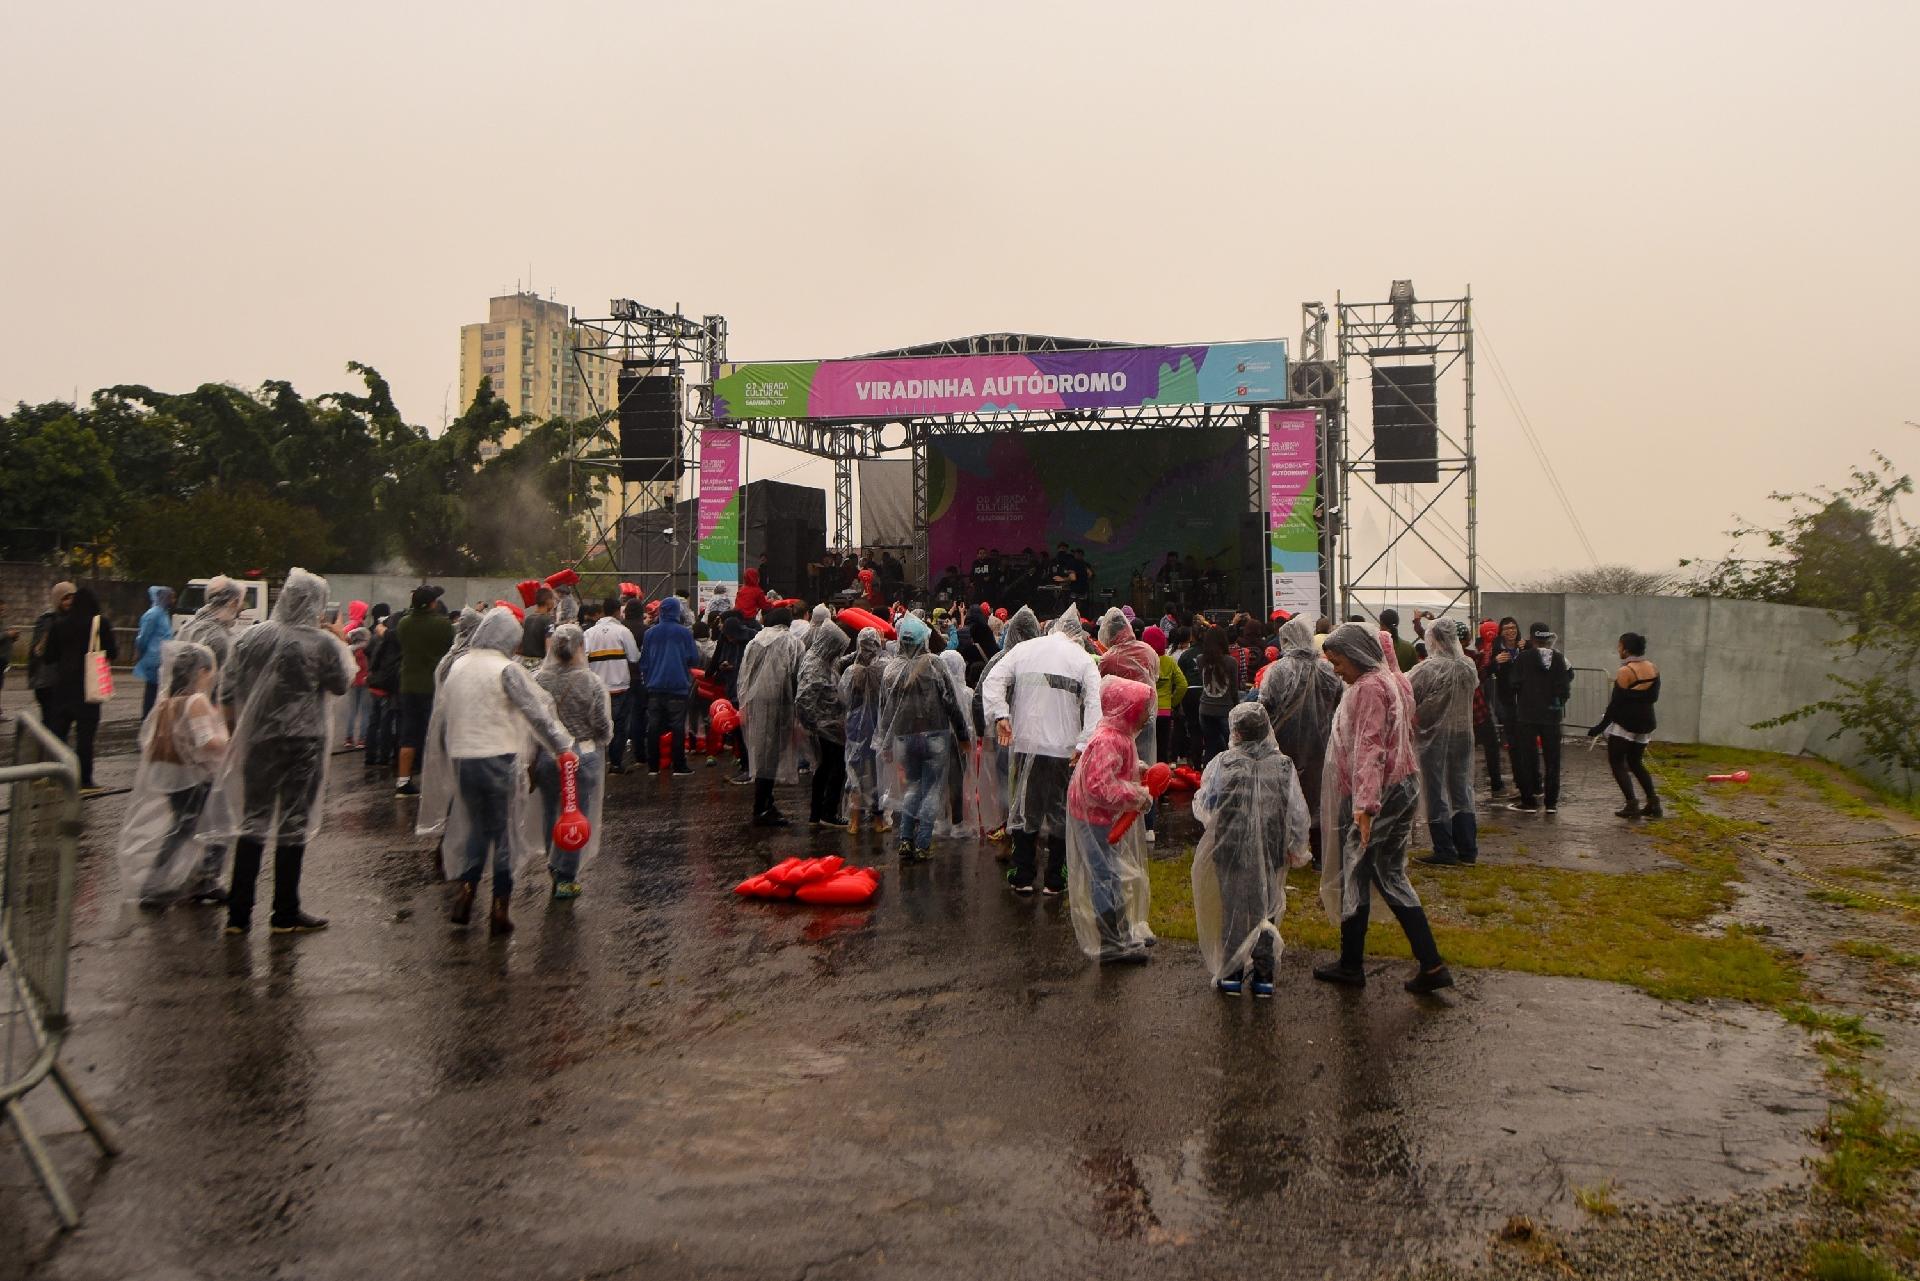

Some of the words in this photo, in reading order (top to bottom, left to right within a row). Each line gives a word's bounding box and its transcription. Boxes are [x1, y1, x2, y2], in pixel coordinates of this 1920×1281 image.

[745, 389, 784, 397] CULTURAL
[762, 382, 789, 390] VIRADA
[856, 378, 976, 400] VIRADINHA
[982, 371, 1127, 396] AUTÓDROMO
[563, 760, 577, 812] Bradesco
